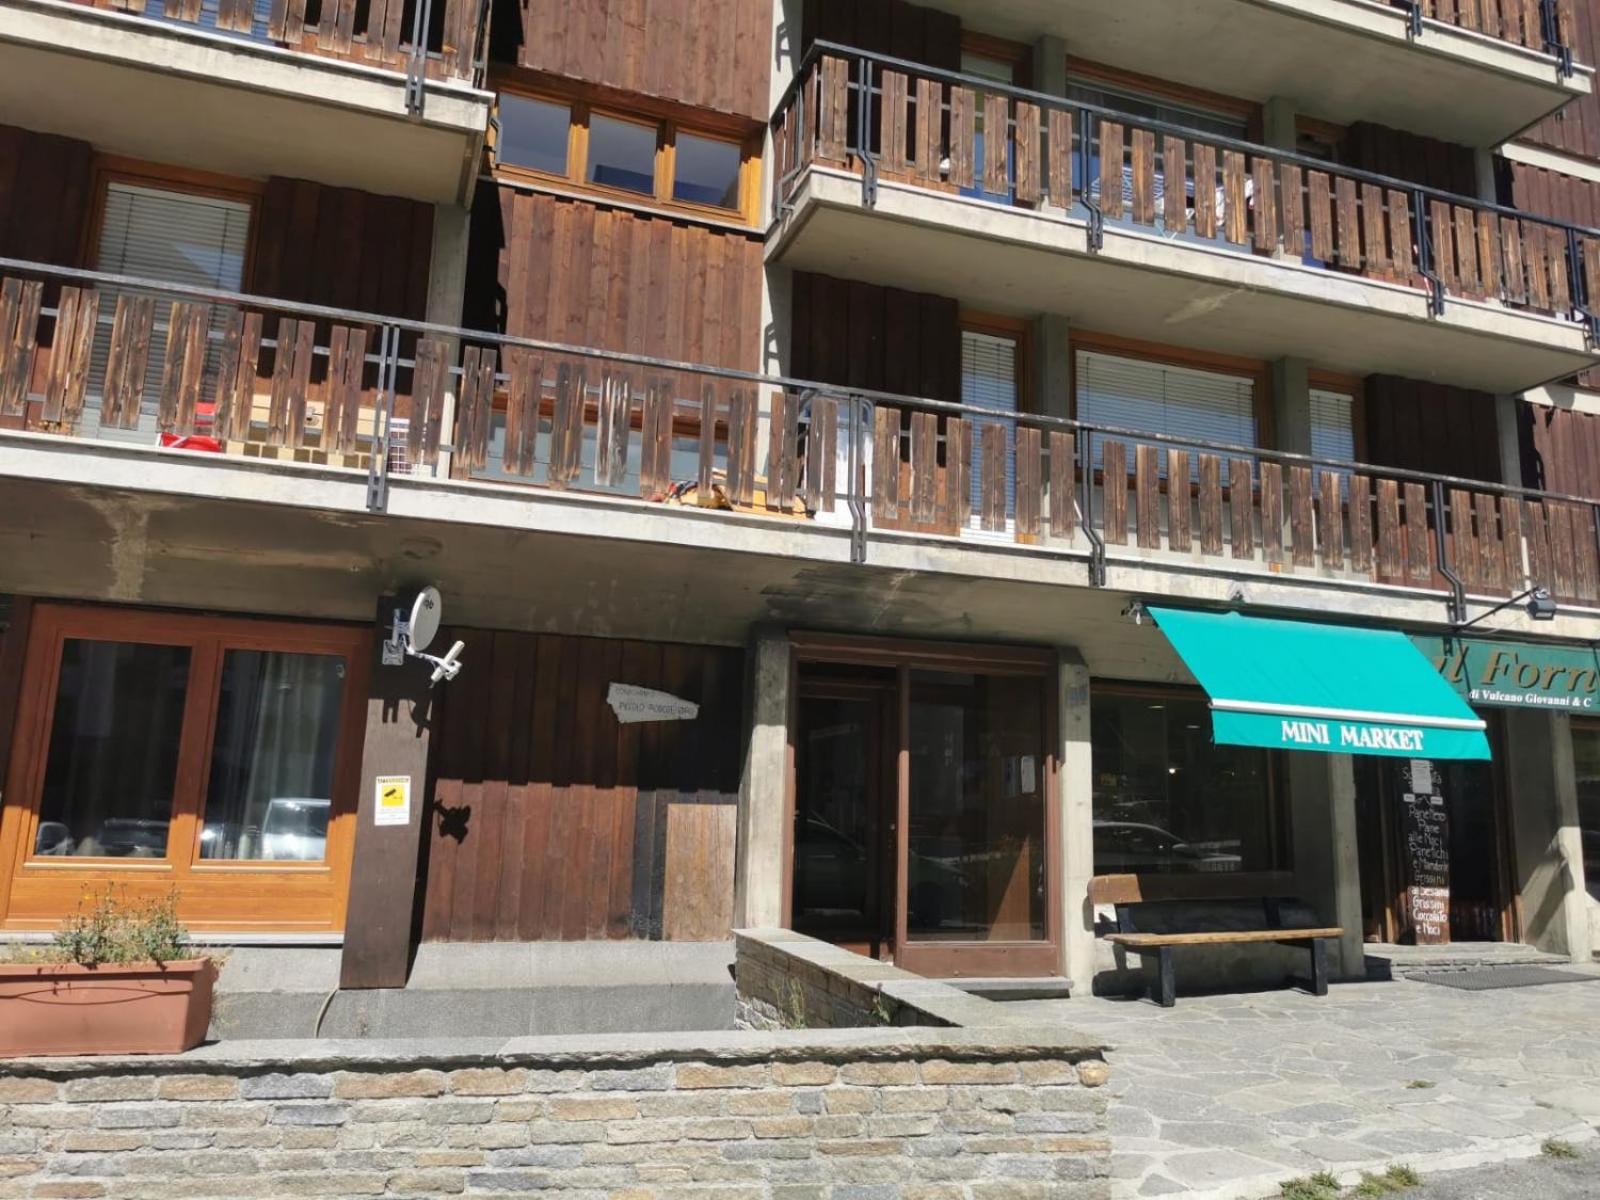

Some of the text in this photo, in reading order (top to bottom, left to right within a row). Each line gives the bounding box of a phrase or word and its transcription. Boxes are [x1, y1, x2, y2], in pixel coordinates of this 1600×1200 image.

[1469, 688, 1480, 700] di
[1482, 690, 1523, 702] Vulcano
[1525, 693, 1570, 706] Giovanni
[1572, 696, 1582, 707] &
[1281, 720, 1424, 750] MINI MARKET
[1412, 895, 1446, 909] Grissini
